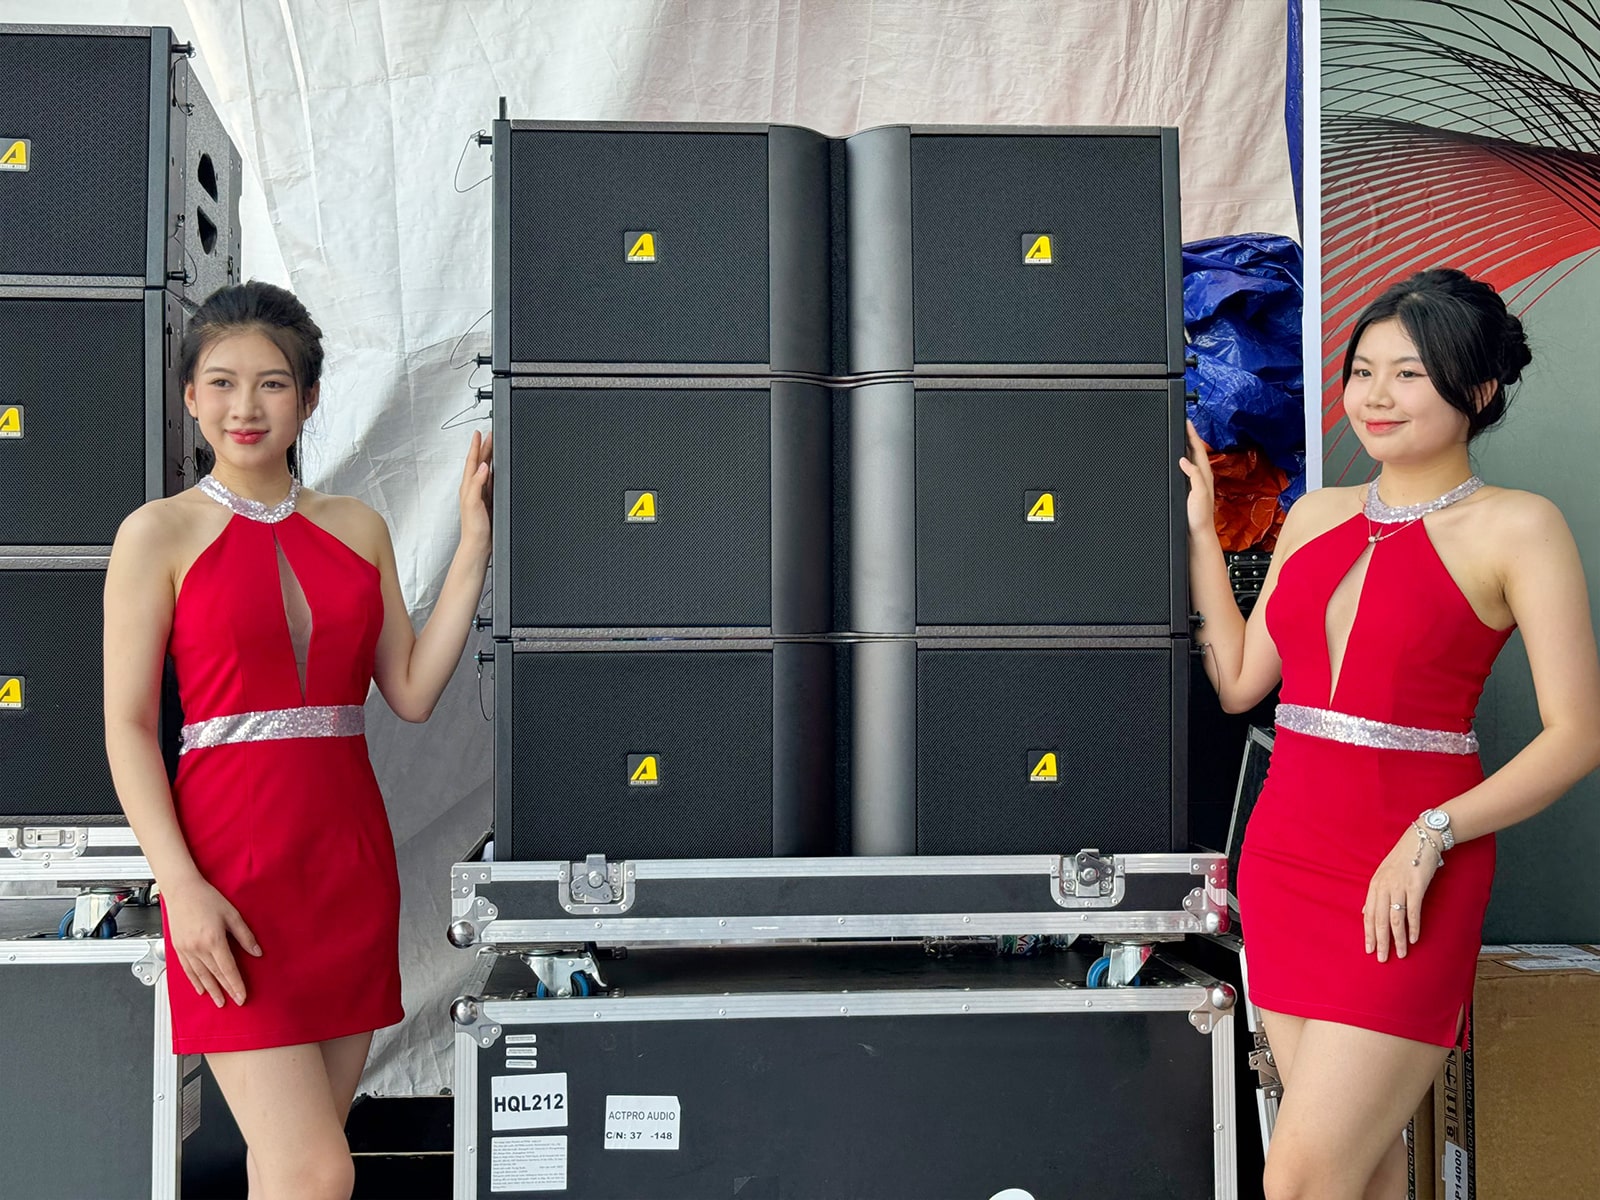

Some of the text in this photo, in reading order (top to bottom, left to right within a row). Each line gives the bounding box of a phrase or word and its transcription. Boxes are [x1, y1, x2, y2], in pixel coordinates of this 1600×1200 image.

[1465, 1062, 1473, 1109] POWER
[494, 1093, 564, 1113] HQL212
[608, 1111, 676, 1121] ACTPRO AUDIO
[605, 1132, 673, 1140] C/N: 37 -148
[1454, 1149, 1462, 1200] P14000
